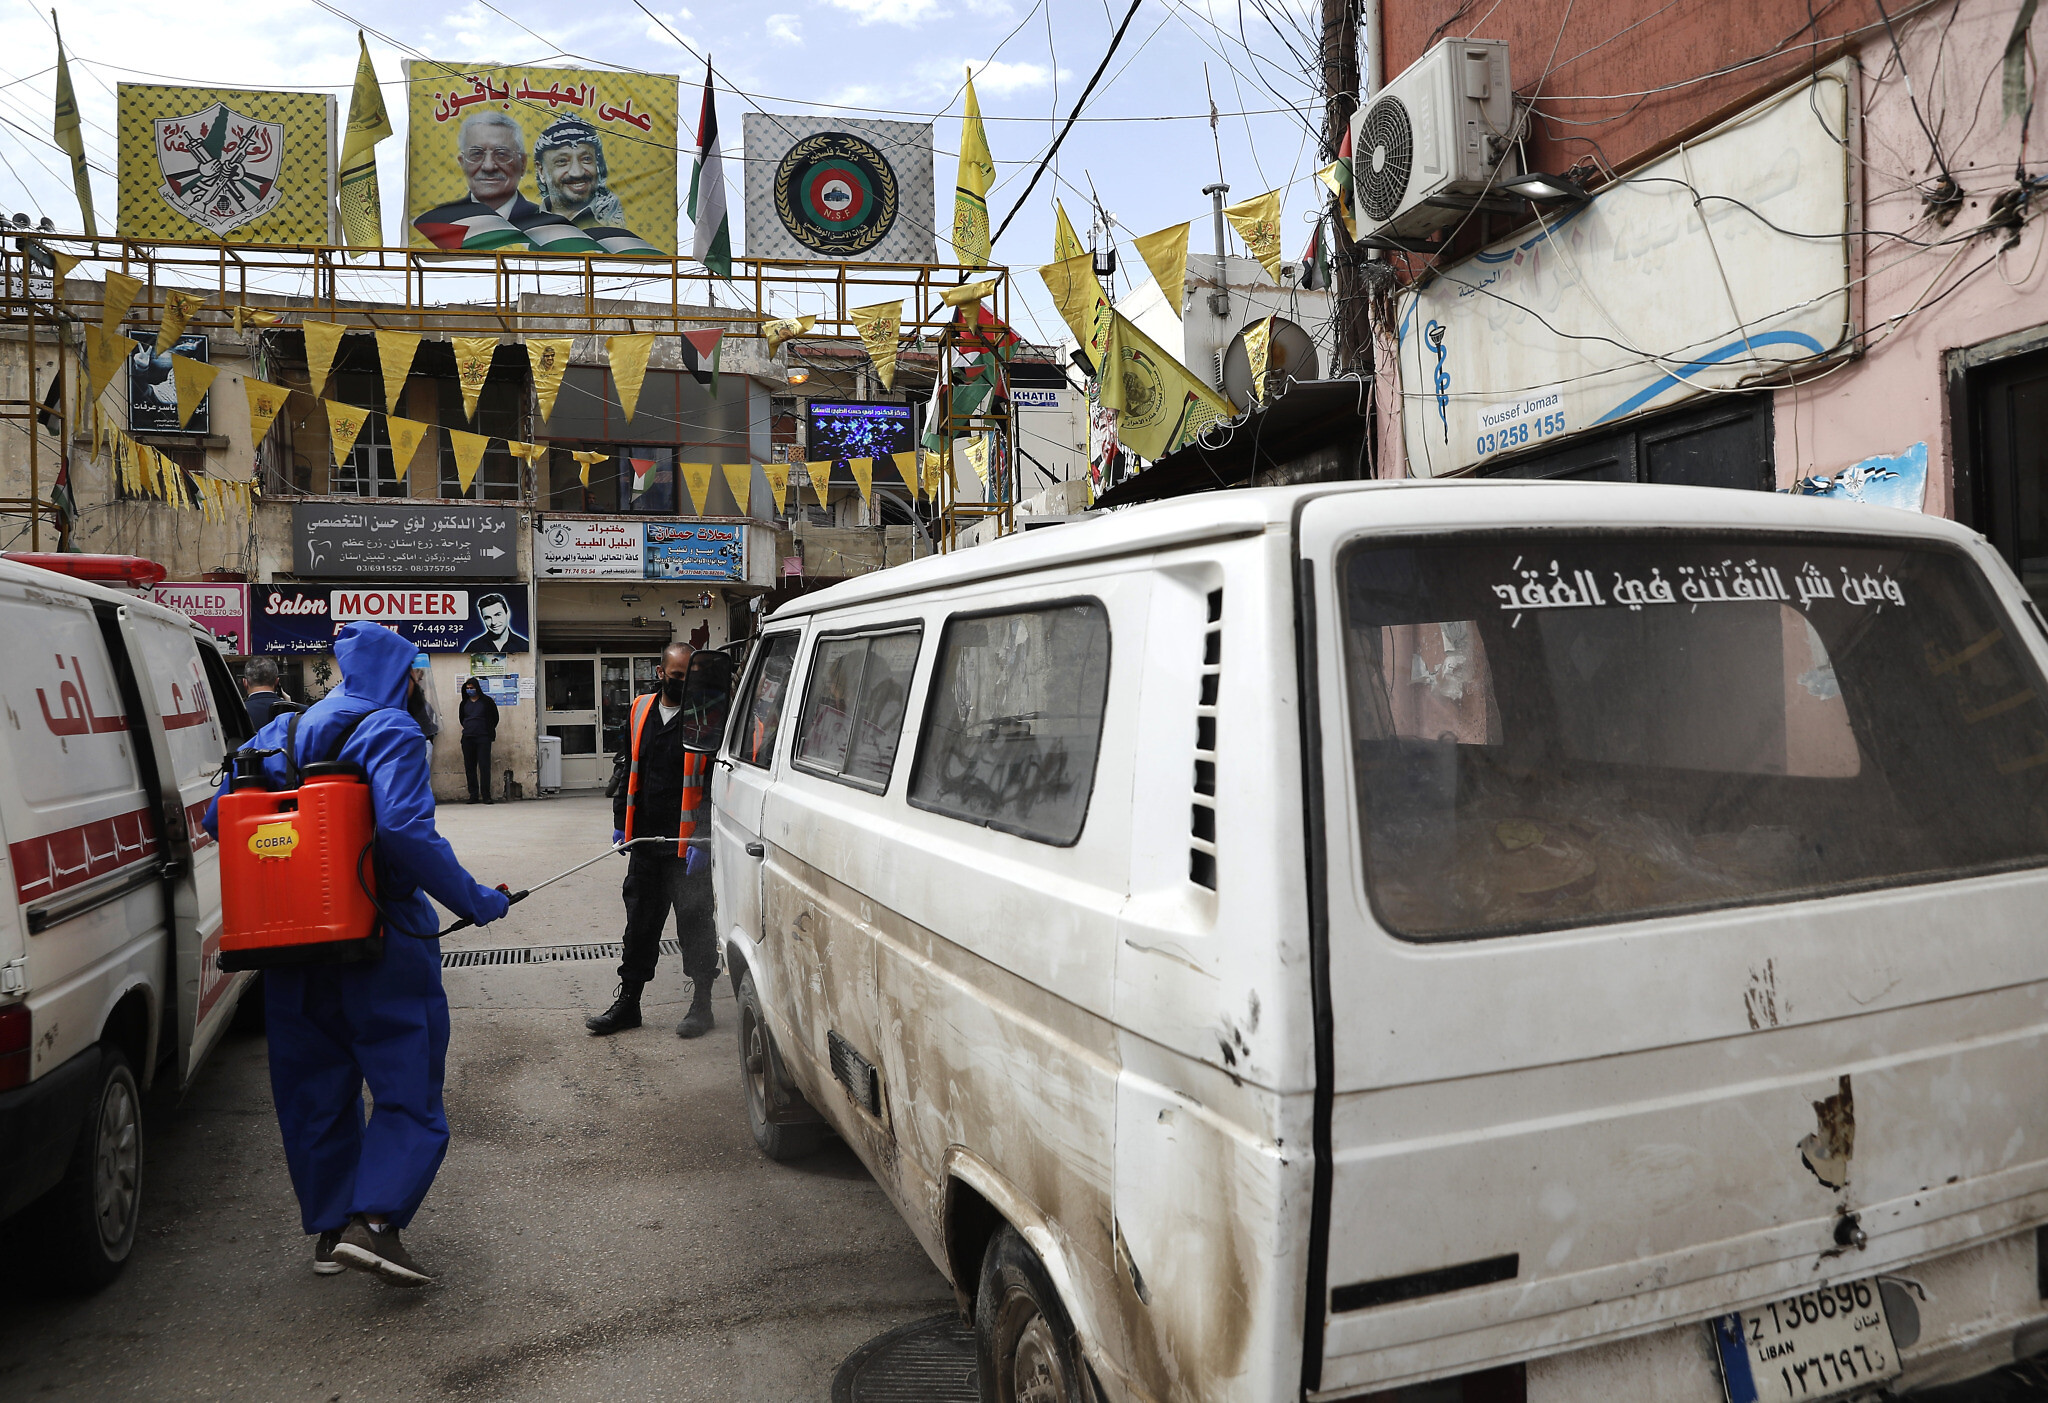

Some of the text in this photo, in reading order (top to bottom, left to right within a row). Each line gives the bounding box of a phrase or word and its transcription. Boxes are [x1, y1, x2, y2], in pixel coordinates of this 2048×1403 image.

[434, 75, 510, 122] باقون
[516, 78, 595, 109] العهد
[598, 99, 652, 133] على
[1013, 391, 1057, 401] KHATIB
[133, 401, 157, 412] عرفات
[1482, 394, 1559, 427] Youssef Jomaa
[1476, 411, 1566, 456] 03/258 155
[307, 514, 506, 534] مركز الدكتور لؤي حسن التخصصي
[587, 523, 625, 534] مختبرات
[655, 528, 733, 541] محلات حمدان
[341, 538, 365, 548] عظم
[367, 539, 383, 550] زرع
[418, 539, 433, 550] زرع
[441, 538, 471, 550] جراحة
[575, 538, 636, 549] الجليل الطبية
[544, 553, 639, 562] كافة التحاليل الطبية والهرمونية
[154, 589, 226, 608] KHALED
[263, 592, 457, 616] Salon MONEER
[412, 622, 446, 633] 76.449
[422, 639, 443, 648] القصات
[443, 638, 459, 648] أحدث
[255, 835, 294, 849] COBRA
[1749, 1276, 1873, 1341] Z 136696
[1853, 1311, 1881, 1332] لبنان
[1759, 1340, 1796, 1362] LIBAN
